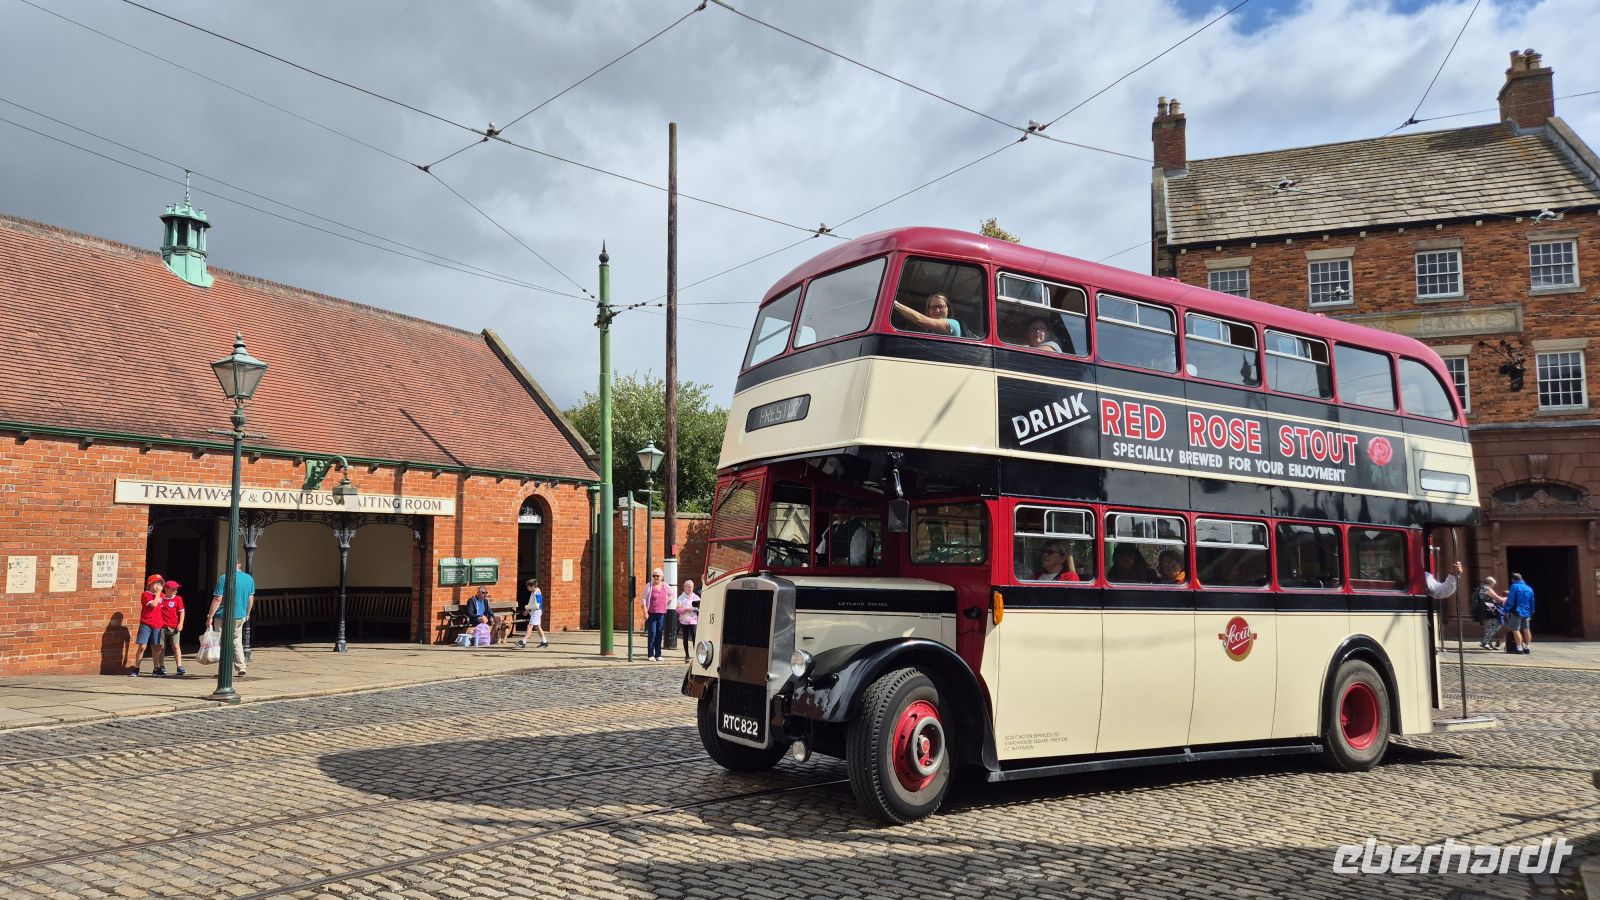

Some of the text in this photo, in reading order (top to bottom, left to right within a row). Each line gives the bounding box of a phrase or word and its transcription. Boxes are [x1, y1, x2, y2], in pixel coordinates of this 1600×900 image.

[759, 398, 803, 424] PREST
[1012, 392, 1089, 439] DRINK
[1100, 397, 1358, 466] RED ROSE STOUT
[1113, 441, 1346, 482] SPECIALLY BREWED FOR YOUR ENJOYMENT
[248, 493, 258, 503] &
[262, 491, 334, 506] OMNIBUS
[404, 498, 442, 511] ROOM
